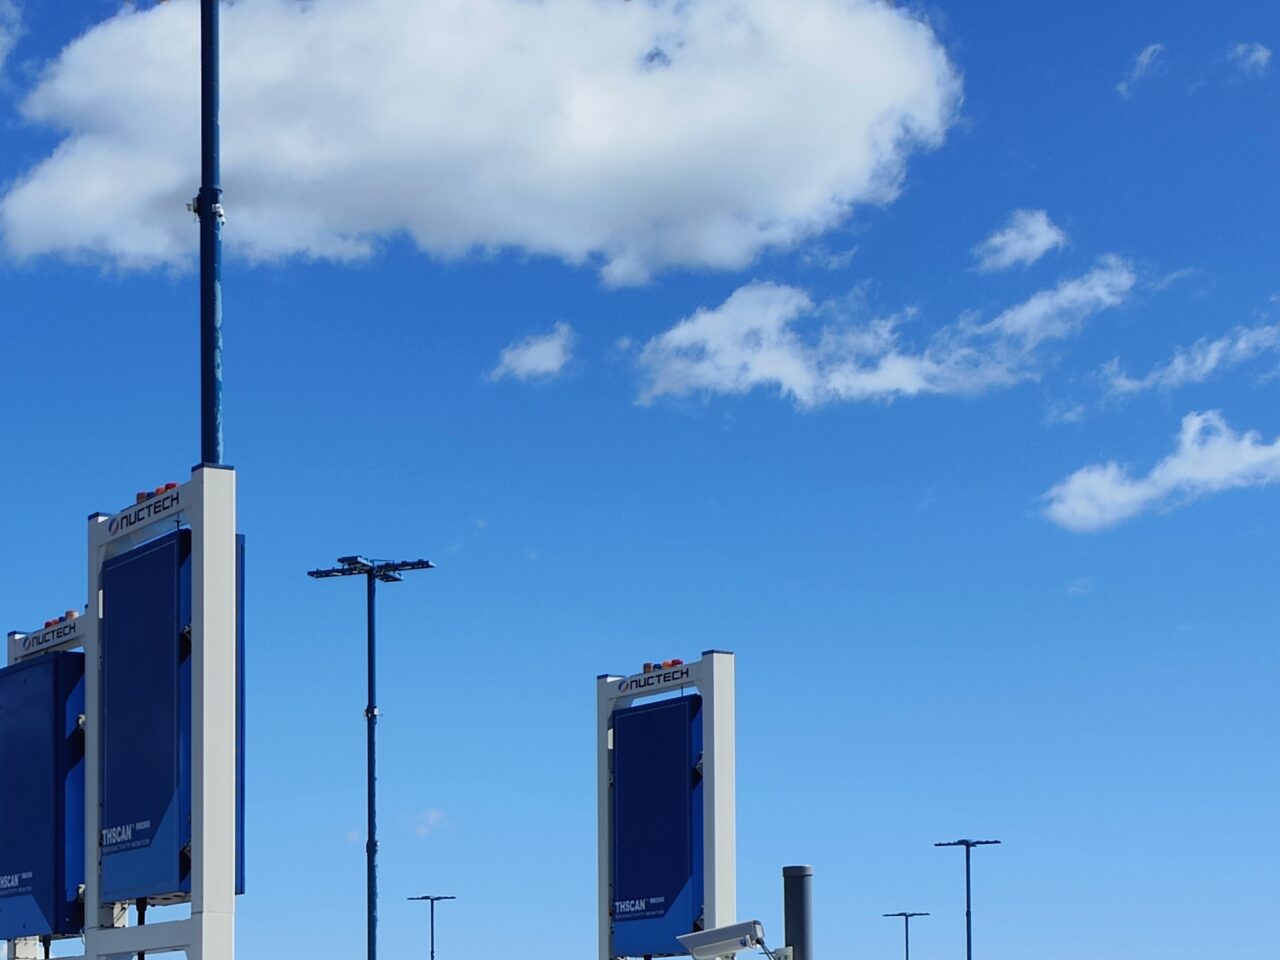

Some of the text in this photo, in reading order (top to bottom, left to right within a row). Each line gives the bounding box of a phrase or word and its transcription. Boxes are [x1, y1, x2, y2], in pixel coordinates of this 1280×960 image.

[120, 492, 179, 530] NUCTECH
[32, 622, 76, 648] NUCTECH
[630, 668, 689, 690] NUCTECH
